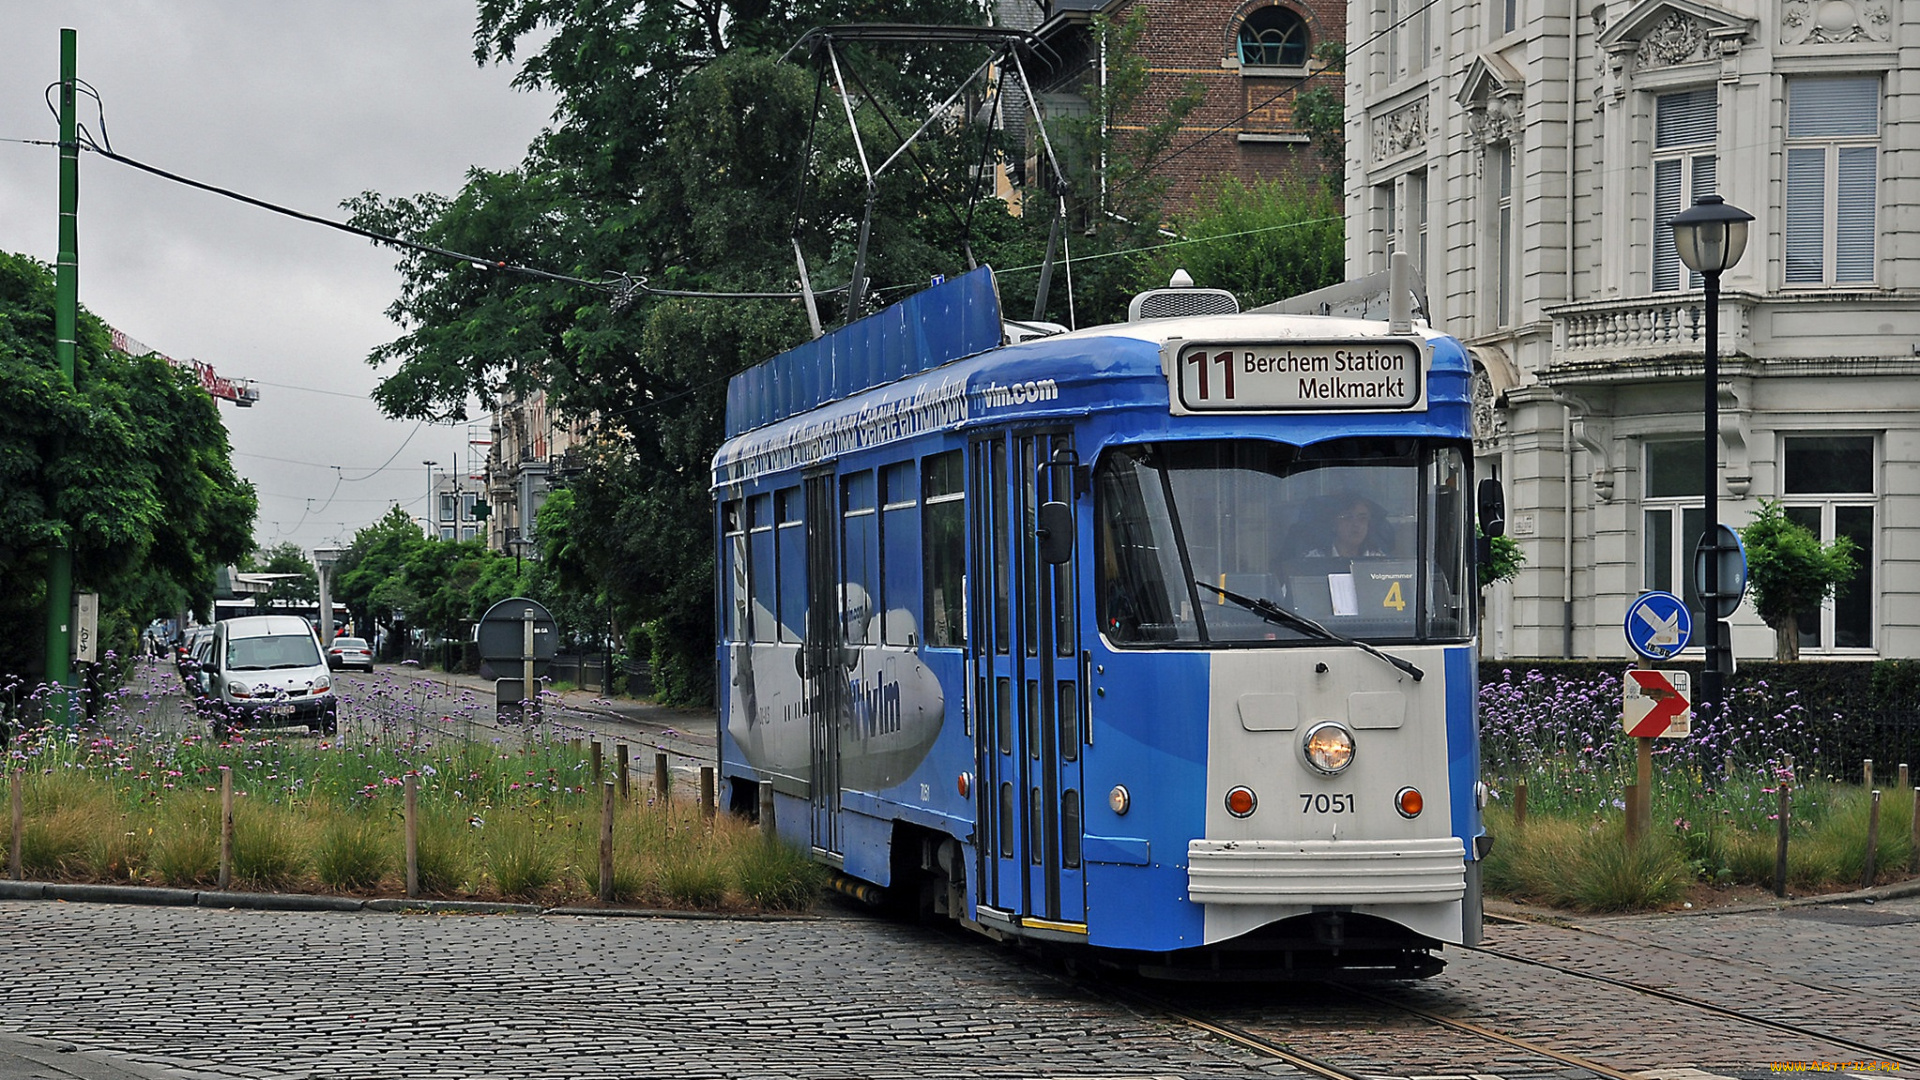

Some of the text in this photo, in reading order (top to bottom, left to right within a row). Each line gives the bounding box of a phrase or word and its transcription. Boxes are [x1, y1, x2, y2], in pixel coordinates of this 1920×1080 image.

[1244, 350, 1404, 373] Berchem Station
[1187, 351, 1235, 400] 11
[1298, 377, 1405, 399] Melkmarkt
[1370, 573, 1413, 581] Volgnummer
[1383, 581, 1406, 611] 4
[1300, 793, 1355, 813] 7051
